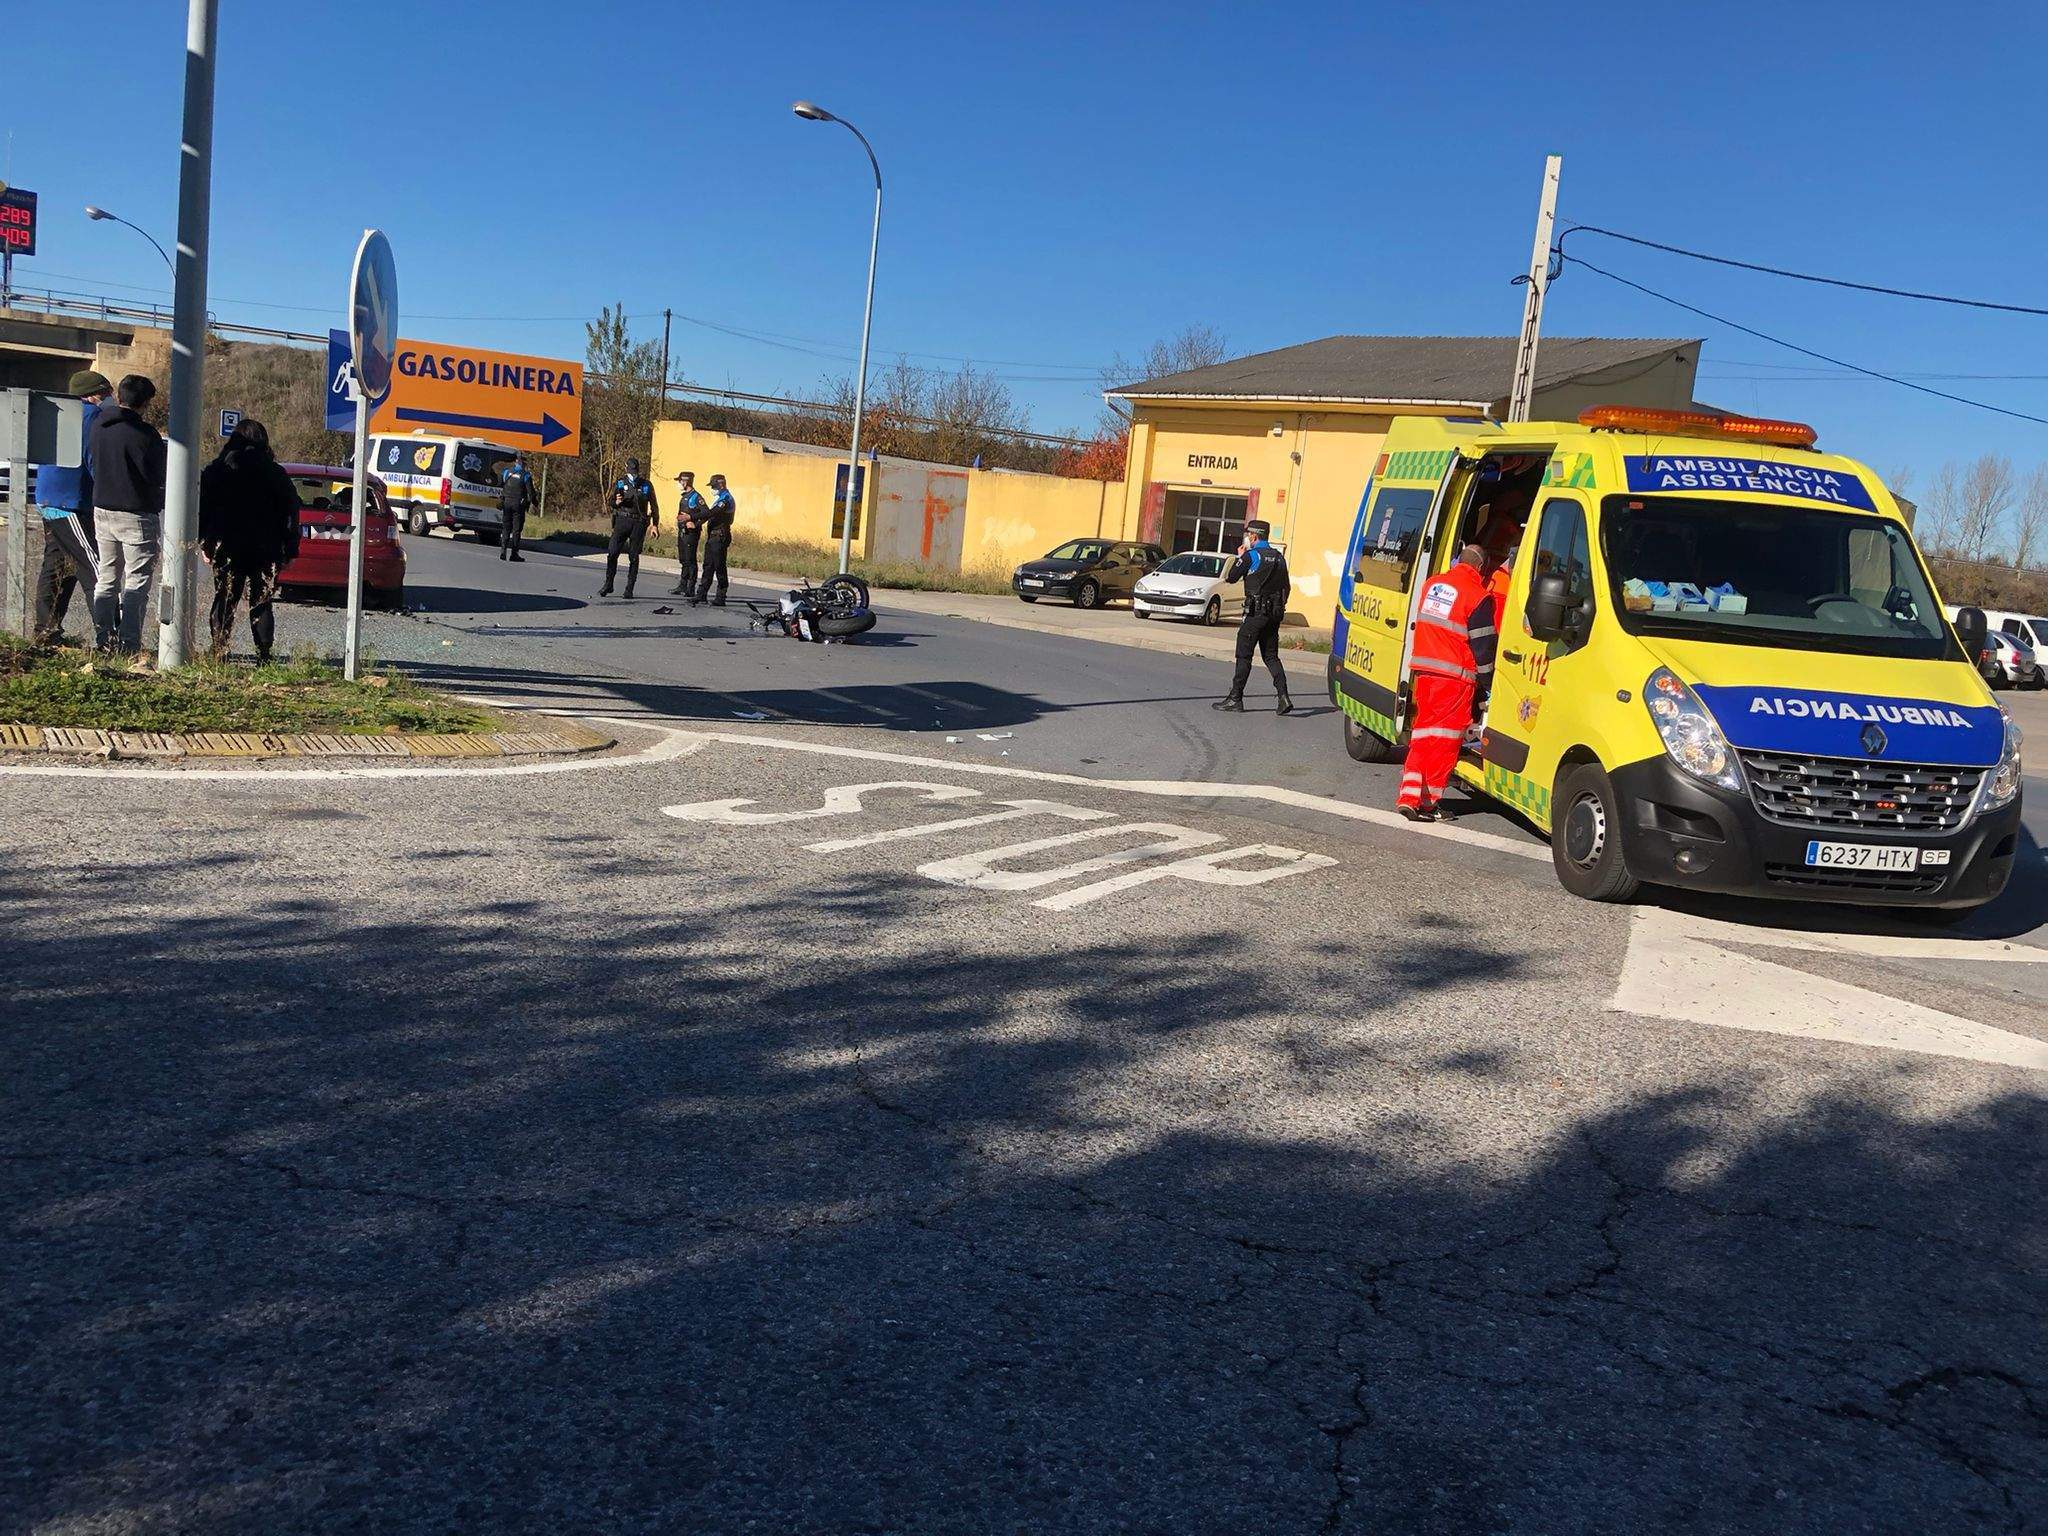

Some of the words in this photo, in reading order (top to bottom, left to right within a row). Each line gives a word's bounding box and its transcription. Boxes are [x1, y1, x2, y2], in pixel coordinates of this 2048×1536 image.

[397, 351, 576, 397] GASOLINERA
[1187, 454, 1238, 470] ENTRADA
[1655, 459, 1842, 487] AMBULANCIA
[382, 472, 432, 486] AMBULANCIA
[1661, 474, 1848, 503] ASISTENCIAL
[1529, 652, 1550, 686] 112
[660, 780, 1339, 912] STOP
[1821, 846, 1871, 866] 6237
[1876, 849, 1913, 869] HTX
[1924, 851, 1948, 863] SP
